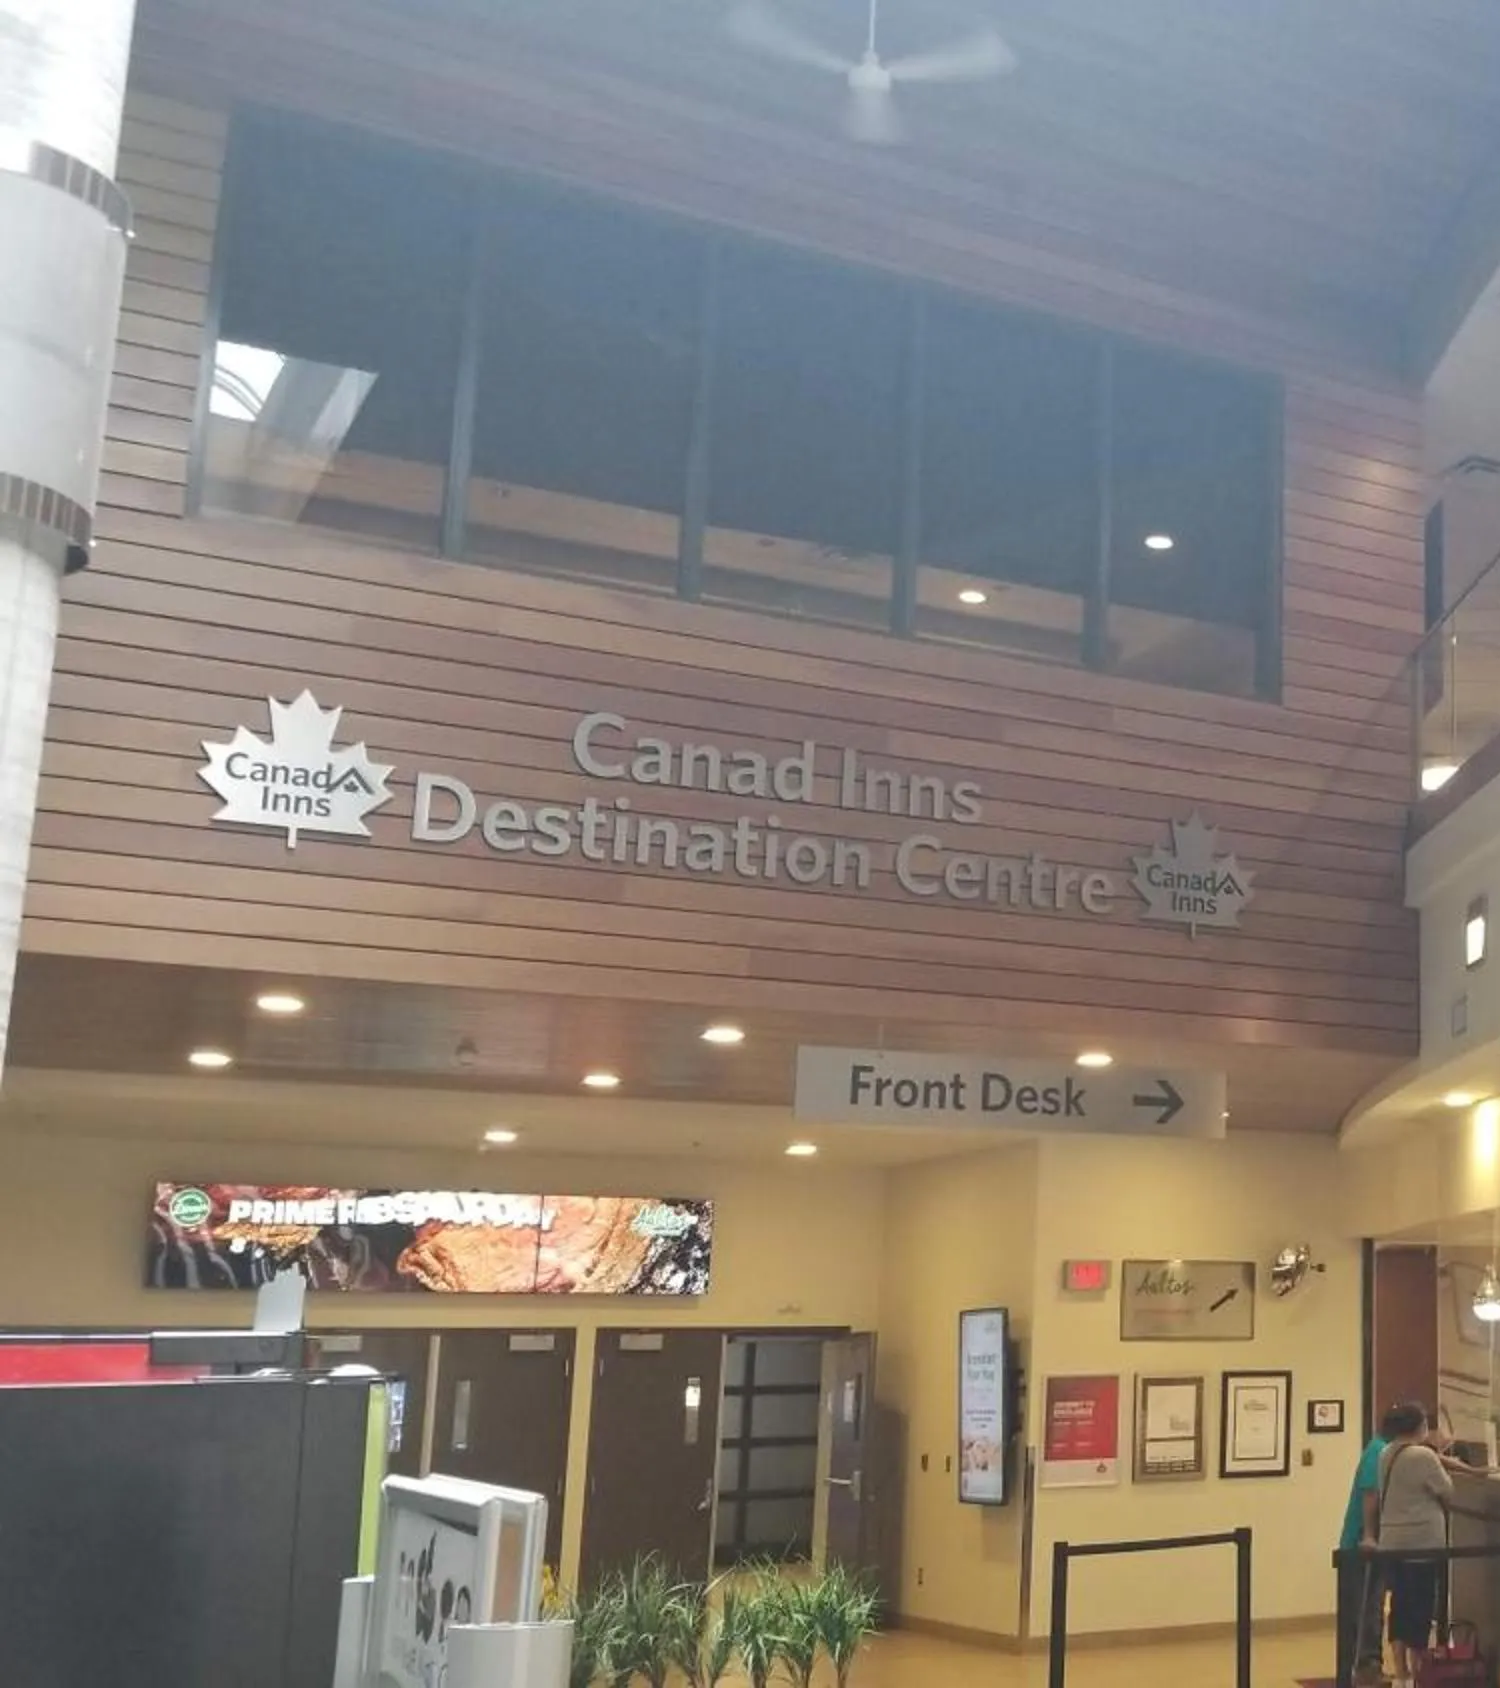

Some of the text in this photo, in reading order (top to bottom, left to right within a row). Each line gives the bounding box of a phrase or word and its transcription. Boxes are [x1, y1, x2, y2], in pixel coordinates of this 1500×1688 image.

[224, 752, 333, 793] Canad
[571, 711, 984, 824] Canad Inns
[260, 786, 331, 817] Inns
[410, 771, 1115, 914] Destination Centre
[1145, 863, 1217, 895] Canad
[1170, 891, 1217, 916] Inns
[849, 1064, 1086, 1117] Front Desk
[228, 1199, 336, 1224] PRIME
